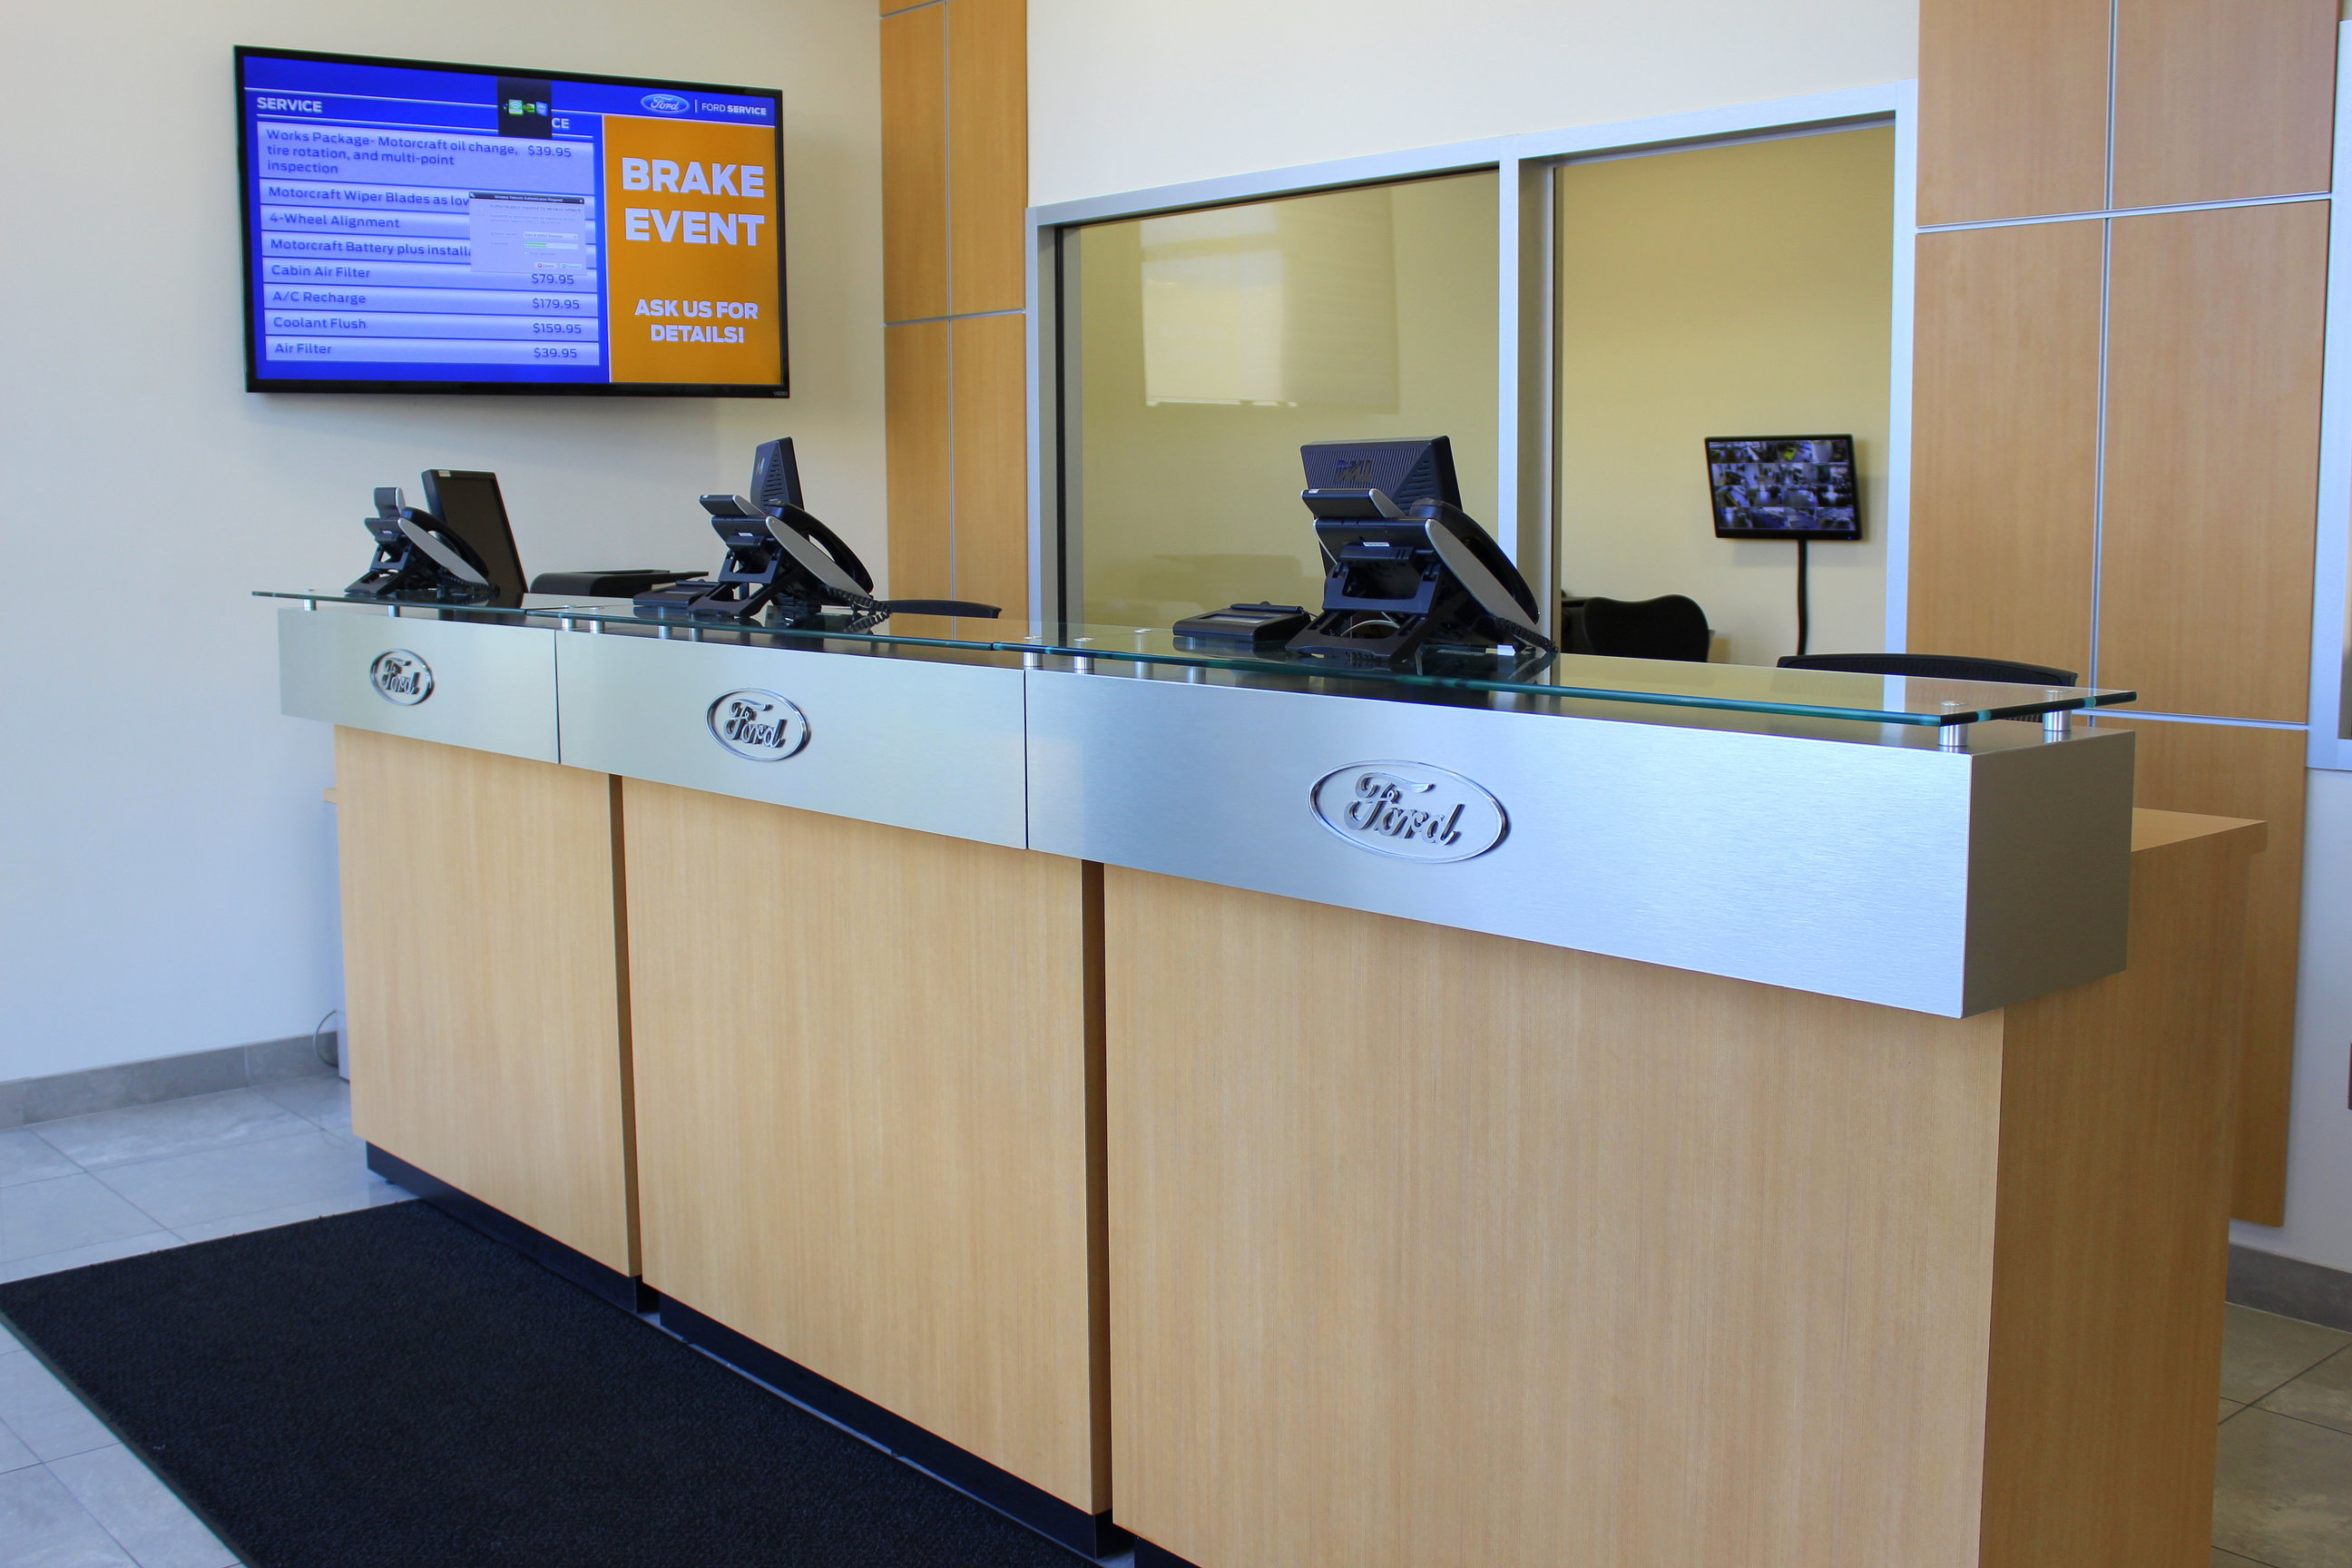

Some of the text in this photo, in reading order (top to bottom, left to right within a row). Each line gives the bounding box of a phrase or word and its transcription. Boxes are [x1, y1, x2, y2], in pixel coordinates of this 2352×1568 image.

[257, 97, 322, 113] SERVICE
[651, 95, 679, 111] Ford
[701, 103, 767, 115] FORD SERVICE
[267, 129, 518, 156] Works Package- Motorcraft oil change,
[268, 145, 455, 165] tire rotation, and multi-point
[528, 145, 572, 158] $39.95
[268, 160, 338, 174] inspection
[622, 157, 765, 198] BRAKE
[269, 186, 340, 201] Motorcraft
[343, 190, 382, 203] Wiper
[386, 191, 429, 204] Blades
[433, 195, 447, 205] as
[270, 212, 400, 228] 4-Wheel Alignment
[624, 208, 765, 246] EVENT
[270, 239, 342, 251] Motorcraft
[346, 241, 394, 255] Battery
[397, 242, 425, 255] plus
[271, 264, 370, 278] Cabin Air Filter
[531, 273, 574, 284] $79.95
[273, 291, 366, 305] A/C Recharge
[533, 298, 580, 309] $179.95
[634, 299, 759, 319] ASK US FOR
[273, 317, 367, 328] Coolant Flush
[533, 322, 582, 334] $159.95
[651, 324, 745, 343] DETAILS!
[275, 343, 332, 354] Air Filter
[534, 348, 577, 358] $39.95
[380, 657, 421, 695] Ford
[723, 698, 788, 749] Ford
[1343, 771, 1467, 846] Ford
